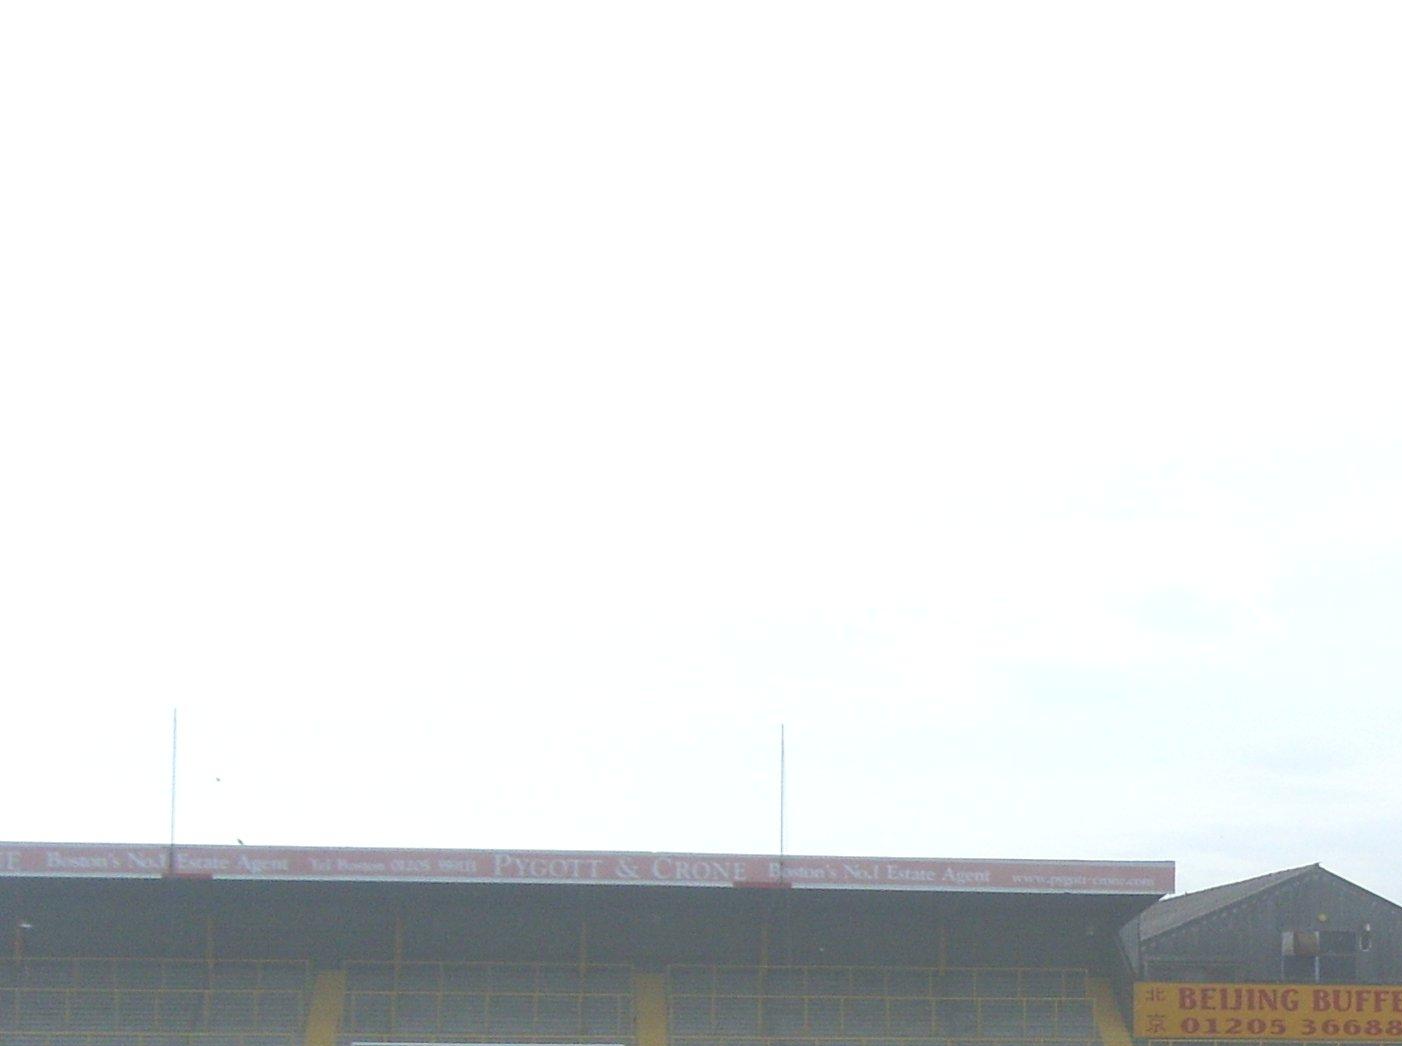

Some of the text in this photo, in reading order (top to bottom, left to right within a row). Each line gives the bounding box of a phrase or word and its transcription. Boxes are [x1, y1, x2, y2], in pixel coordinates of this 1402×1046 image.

[46, 852, 121, 868] Boston's
[238, 854, 289, 874] Agent
[494, 855, 604, 879] PYGOTT
[616, 861, 640, 878] &
[653, 858, 746, 880] CRONE
[769, 862, 837, 879] Boston's
[887, 864, 936, 881] Estate
[942, 867, 991, 884] Agent
[1178, 986, 1300, 1012] BEIJING
[1180, 1017, 1287, 1035] 01205
